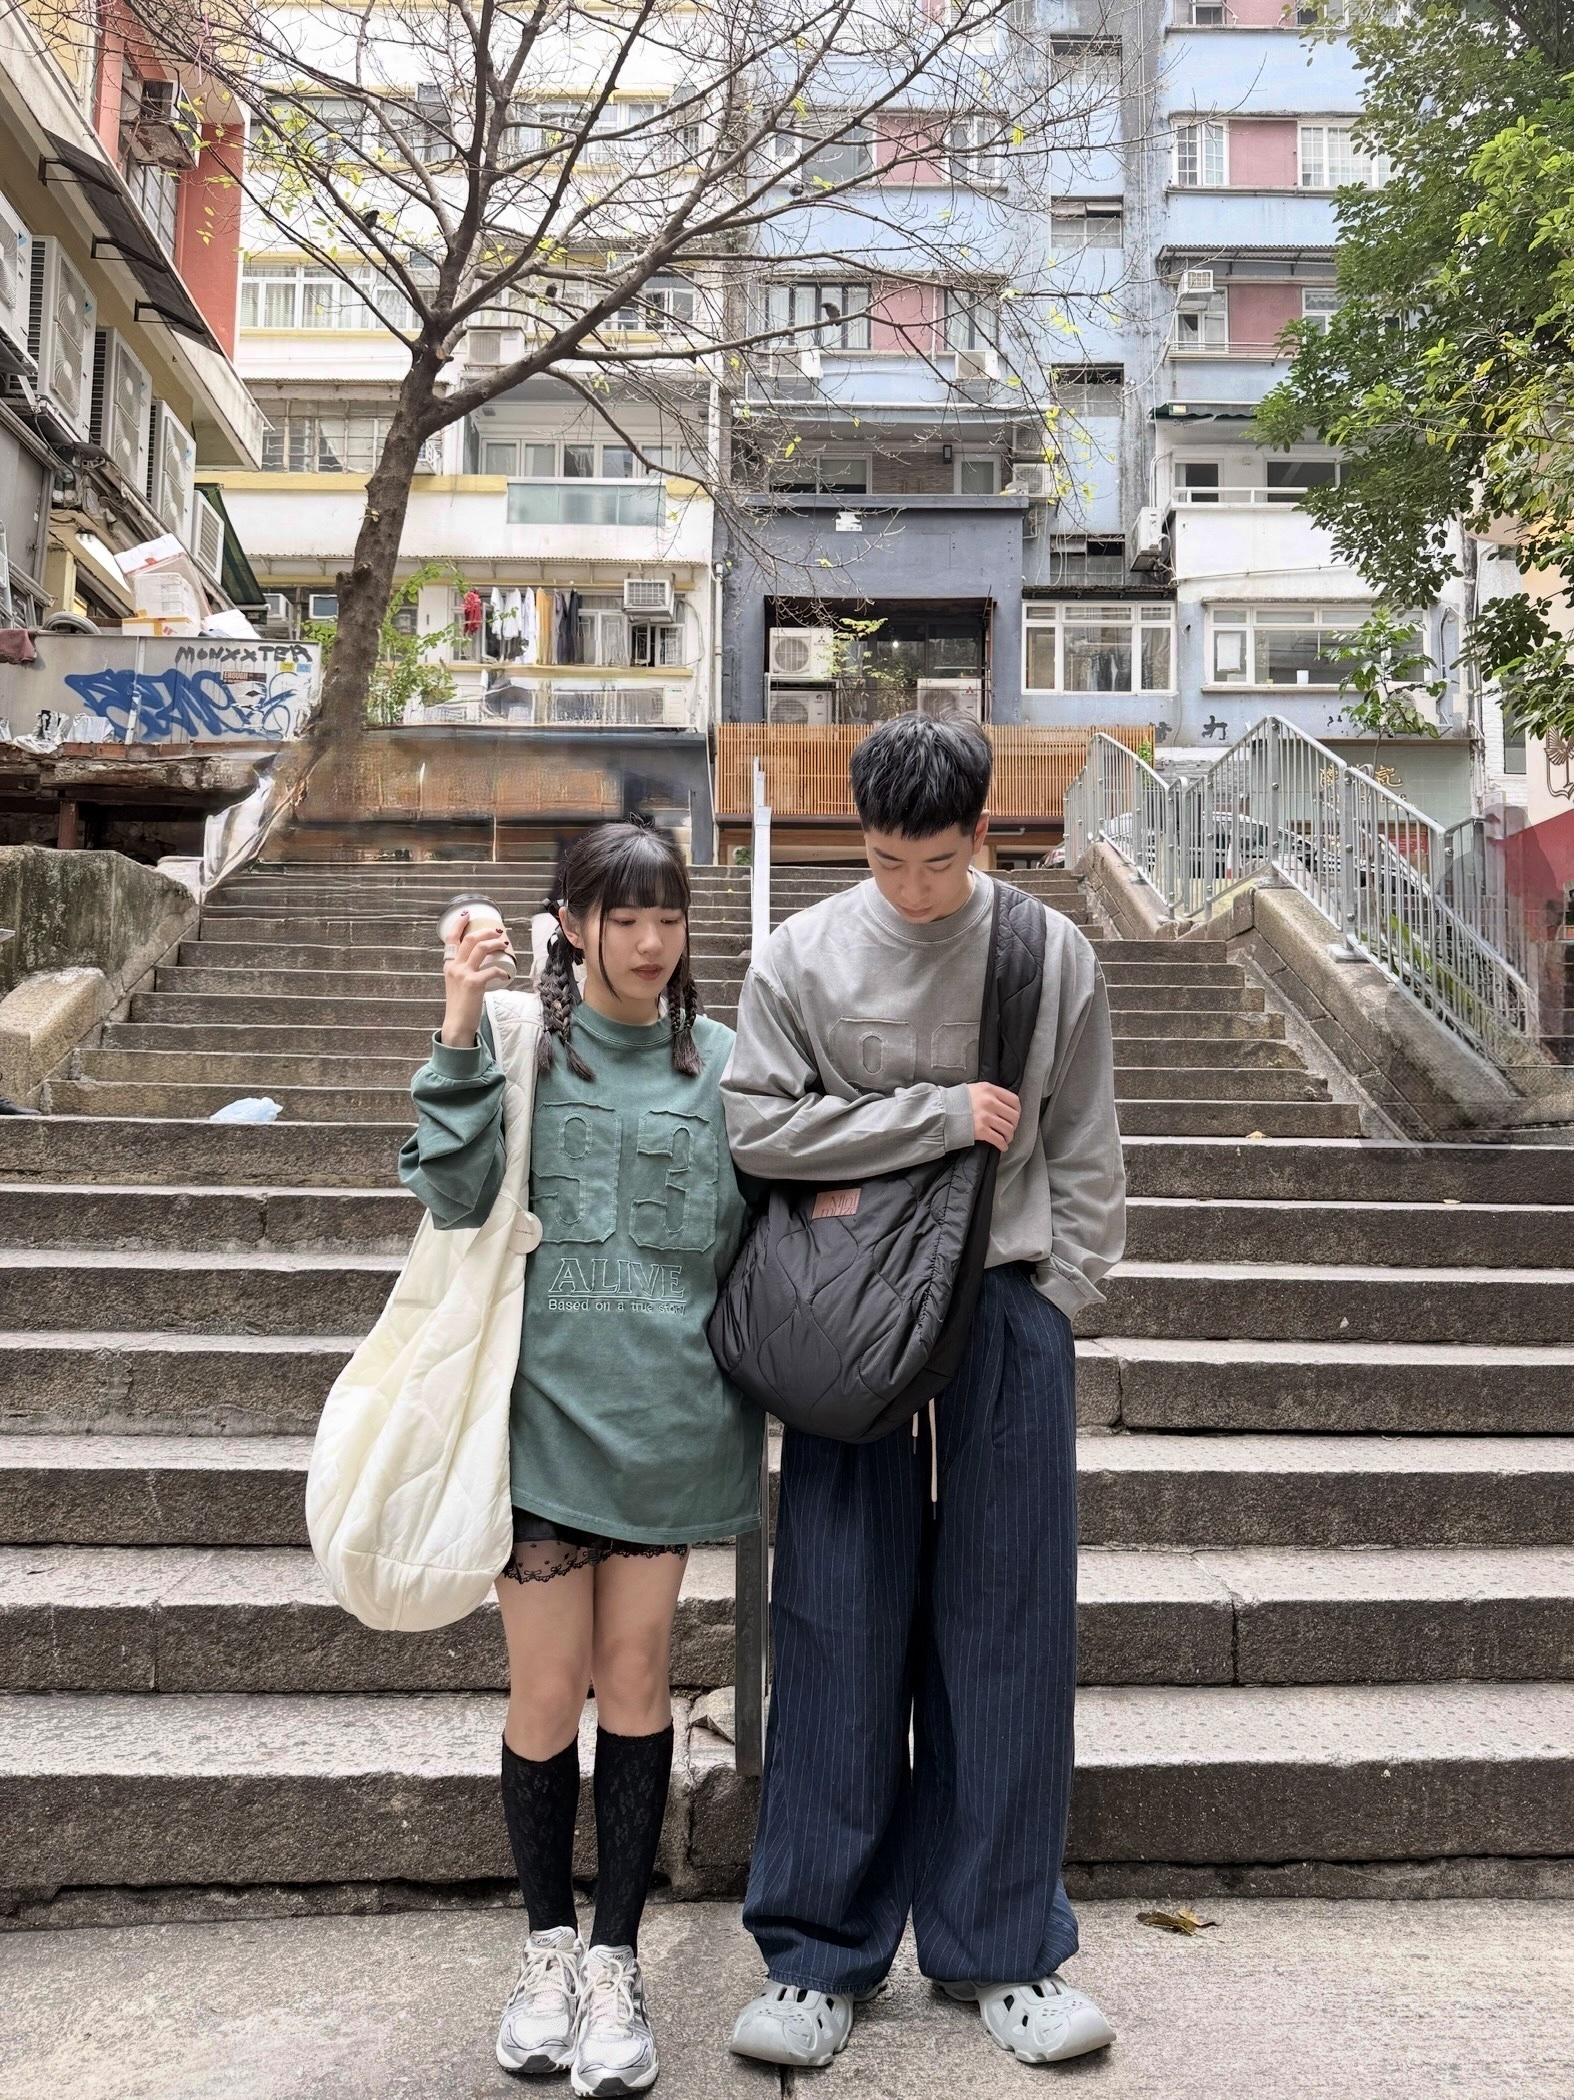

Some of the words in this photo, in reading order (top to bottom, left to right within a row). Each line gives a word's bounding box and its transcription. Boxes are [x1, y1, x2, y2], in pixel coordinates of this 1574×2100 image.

[548, 1257, 685, 1299] ALIVE
[548, 1299, 589, 1312] Based
[595, 1301, 610, 1312] on
[617, 1302, 625, 1312] a
[631, 1301, 653, 1313] true
